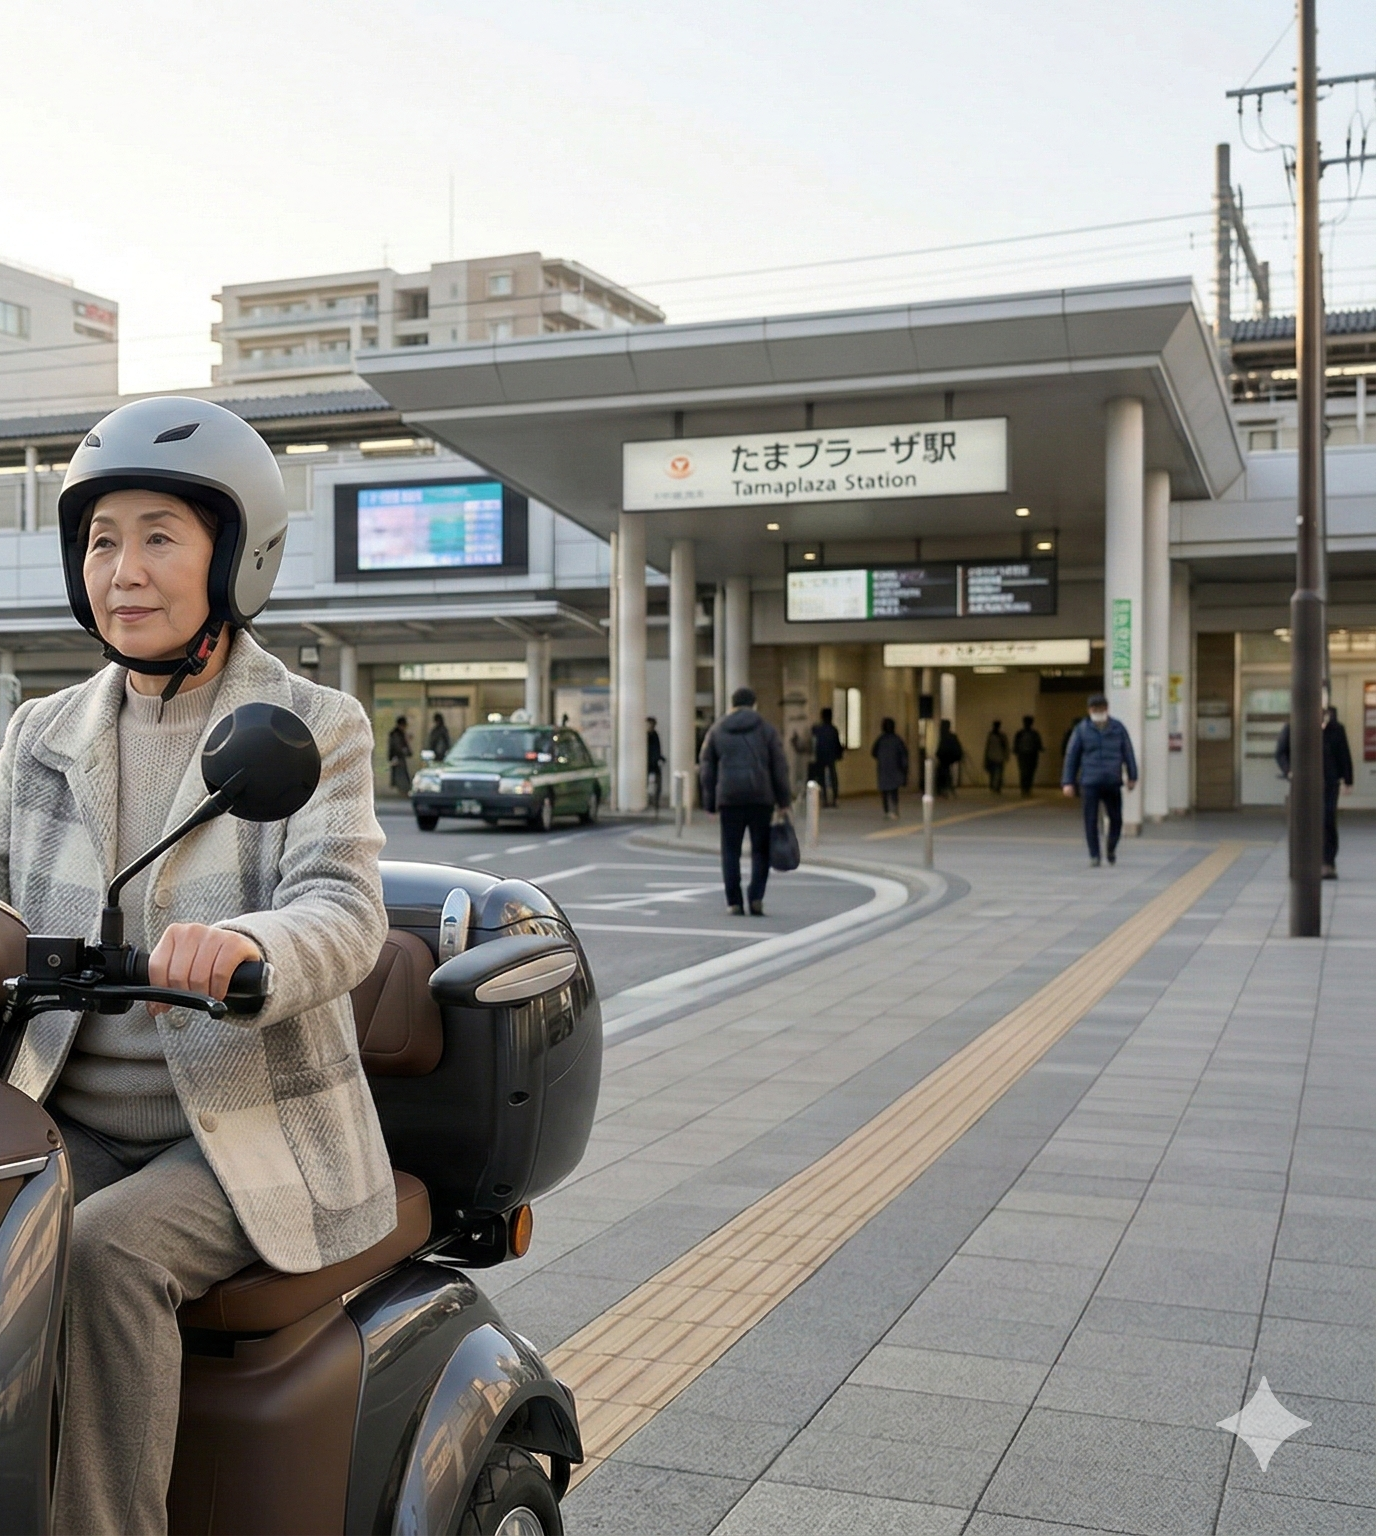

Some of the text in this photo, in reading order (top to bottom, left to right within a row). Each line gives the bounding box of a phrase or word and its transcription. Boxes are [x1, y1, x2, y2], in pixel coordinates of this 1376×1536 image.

[732, 431, 956, 472] たまプラーザ駅
[732, 471, 917, 498] Tamaplaza Station
